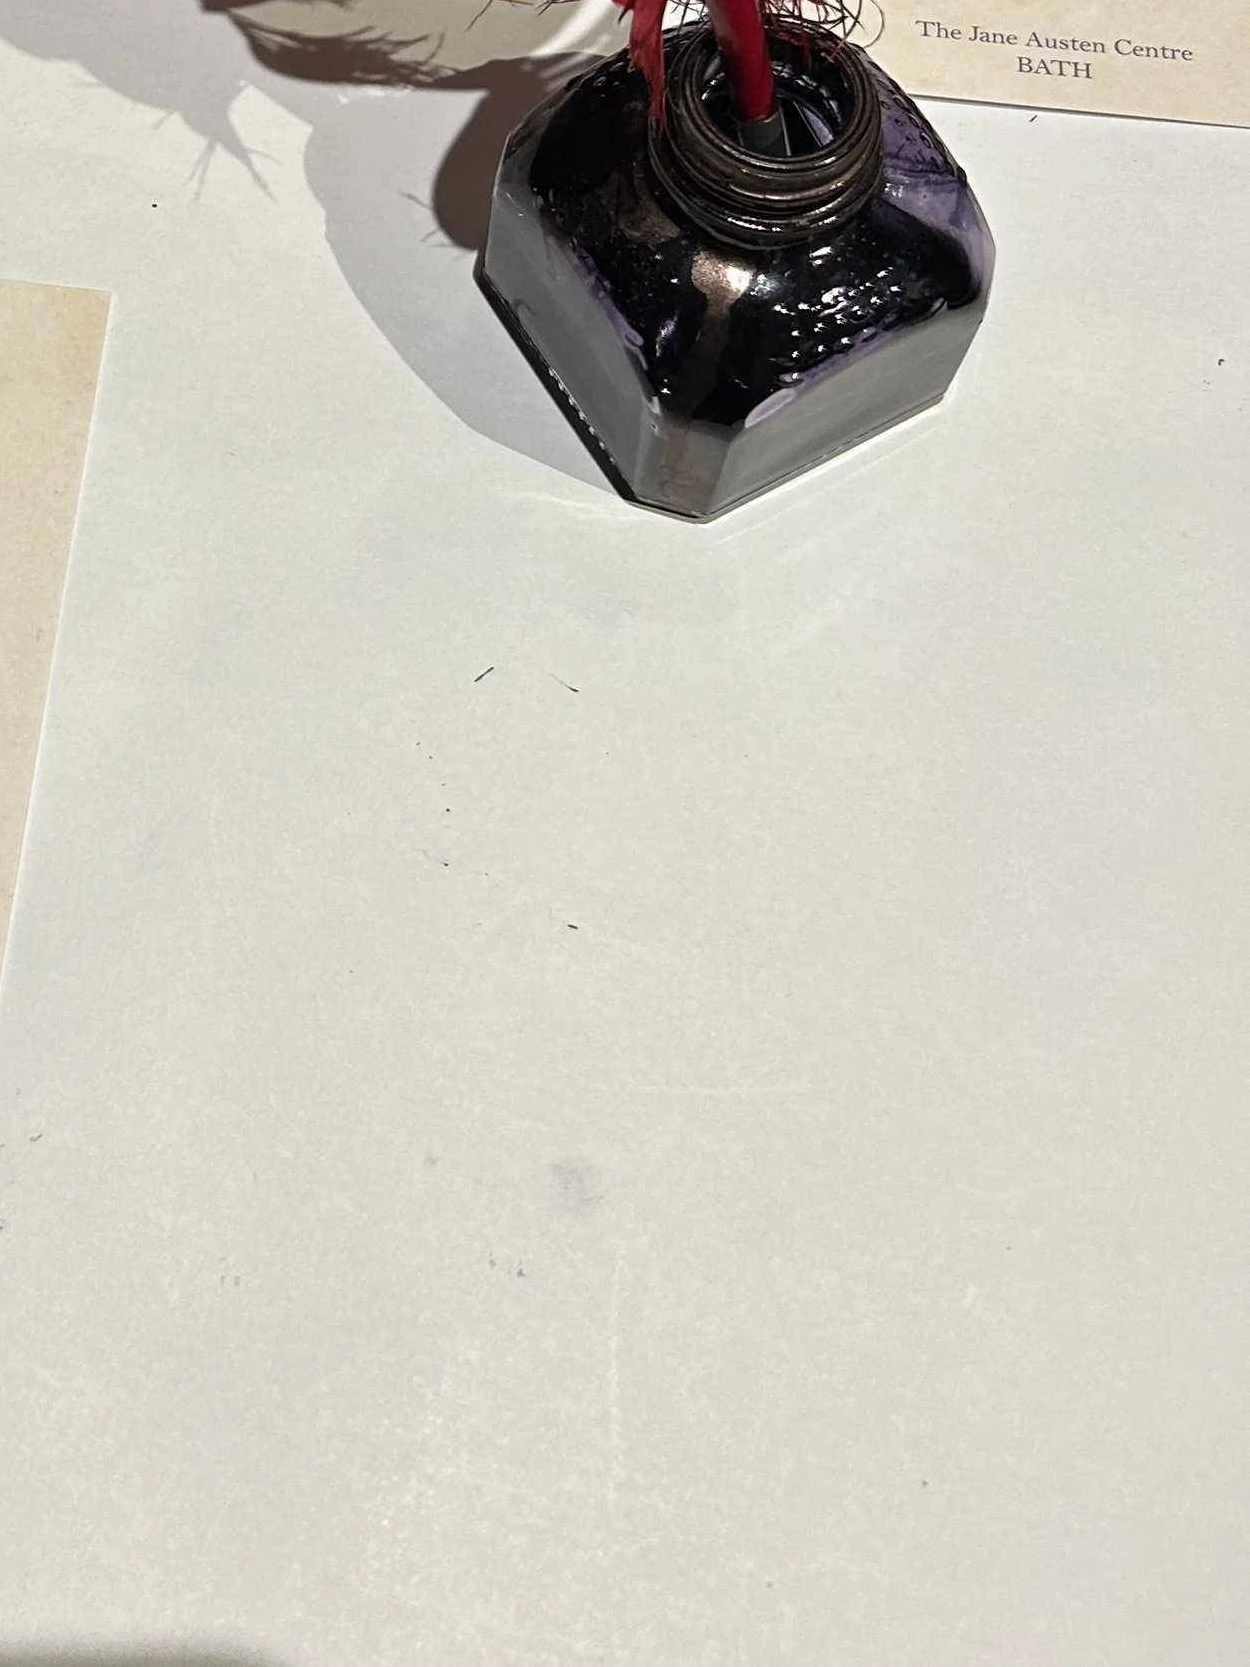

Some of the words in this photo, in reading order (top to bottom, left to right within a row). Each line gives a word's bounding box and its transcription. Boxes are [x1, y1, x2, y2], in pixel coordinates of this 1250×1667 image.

[915, 20, 963, 41] The
[968, 26, 1019, 47] Jane
[1025, 32, 1107, 55] Austen
[1113, 39, 1195, 62] Centre
[1016, 56, 1094, 80] BATH
